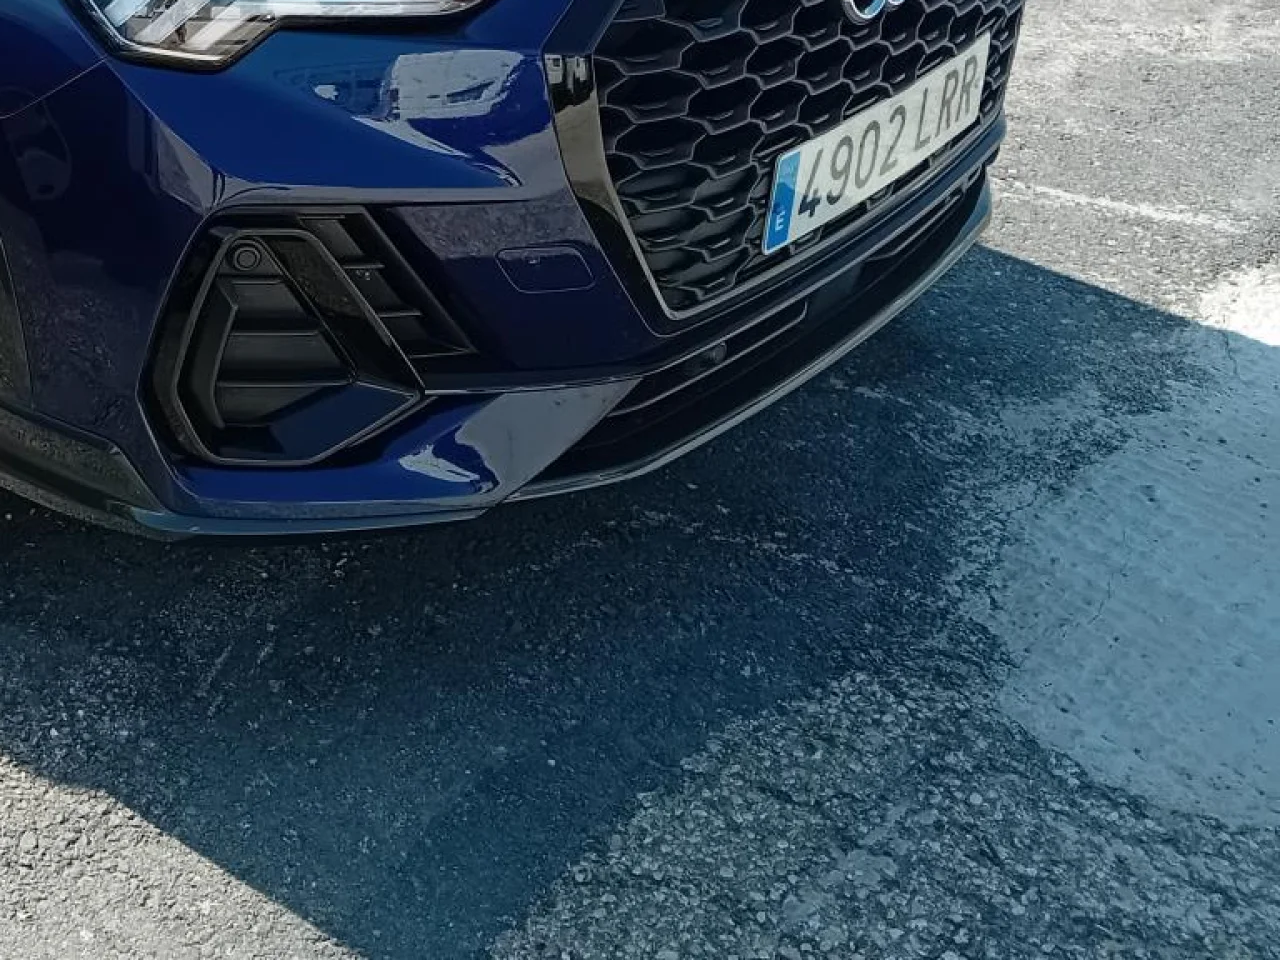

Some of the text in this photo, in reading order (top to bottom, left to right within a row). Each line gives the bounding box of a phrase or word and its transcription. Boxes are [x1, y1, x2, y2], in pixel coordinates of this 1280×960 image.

[797, 54, 979, 219] 4902 LRR
[773, 210, 785, 232] E
